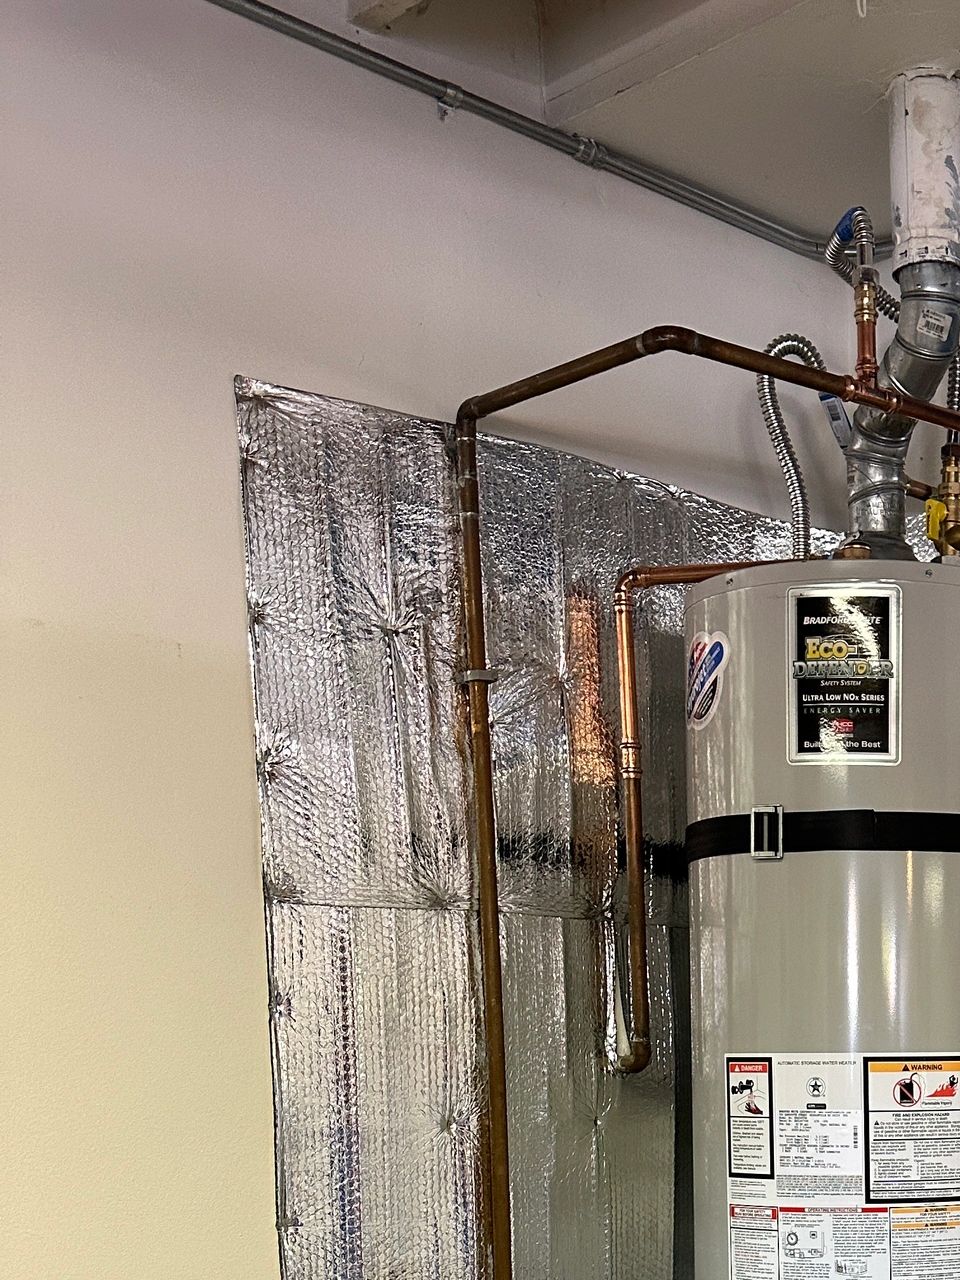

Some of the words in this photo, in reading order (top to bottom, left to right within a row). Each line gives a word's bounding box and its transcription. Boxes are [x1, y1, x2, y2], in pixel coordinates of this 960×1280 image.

[793, 660, 894, 679] DEFENDER
[802, 694, 824, 702] ULTRA
[825, 693, 842, 701] LOW
[843, 693, 860, 701] NOx
[861, 693, 885, 702] SERIES
